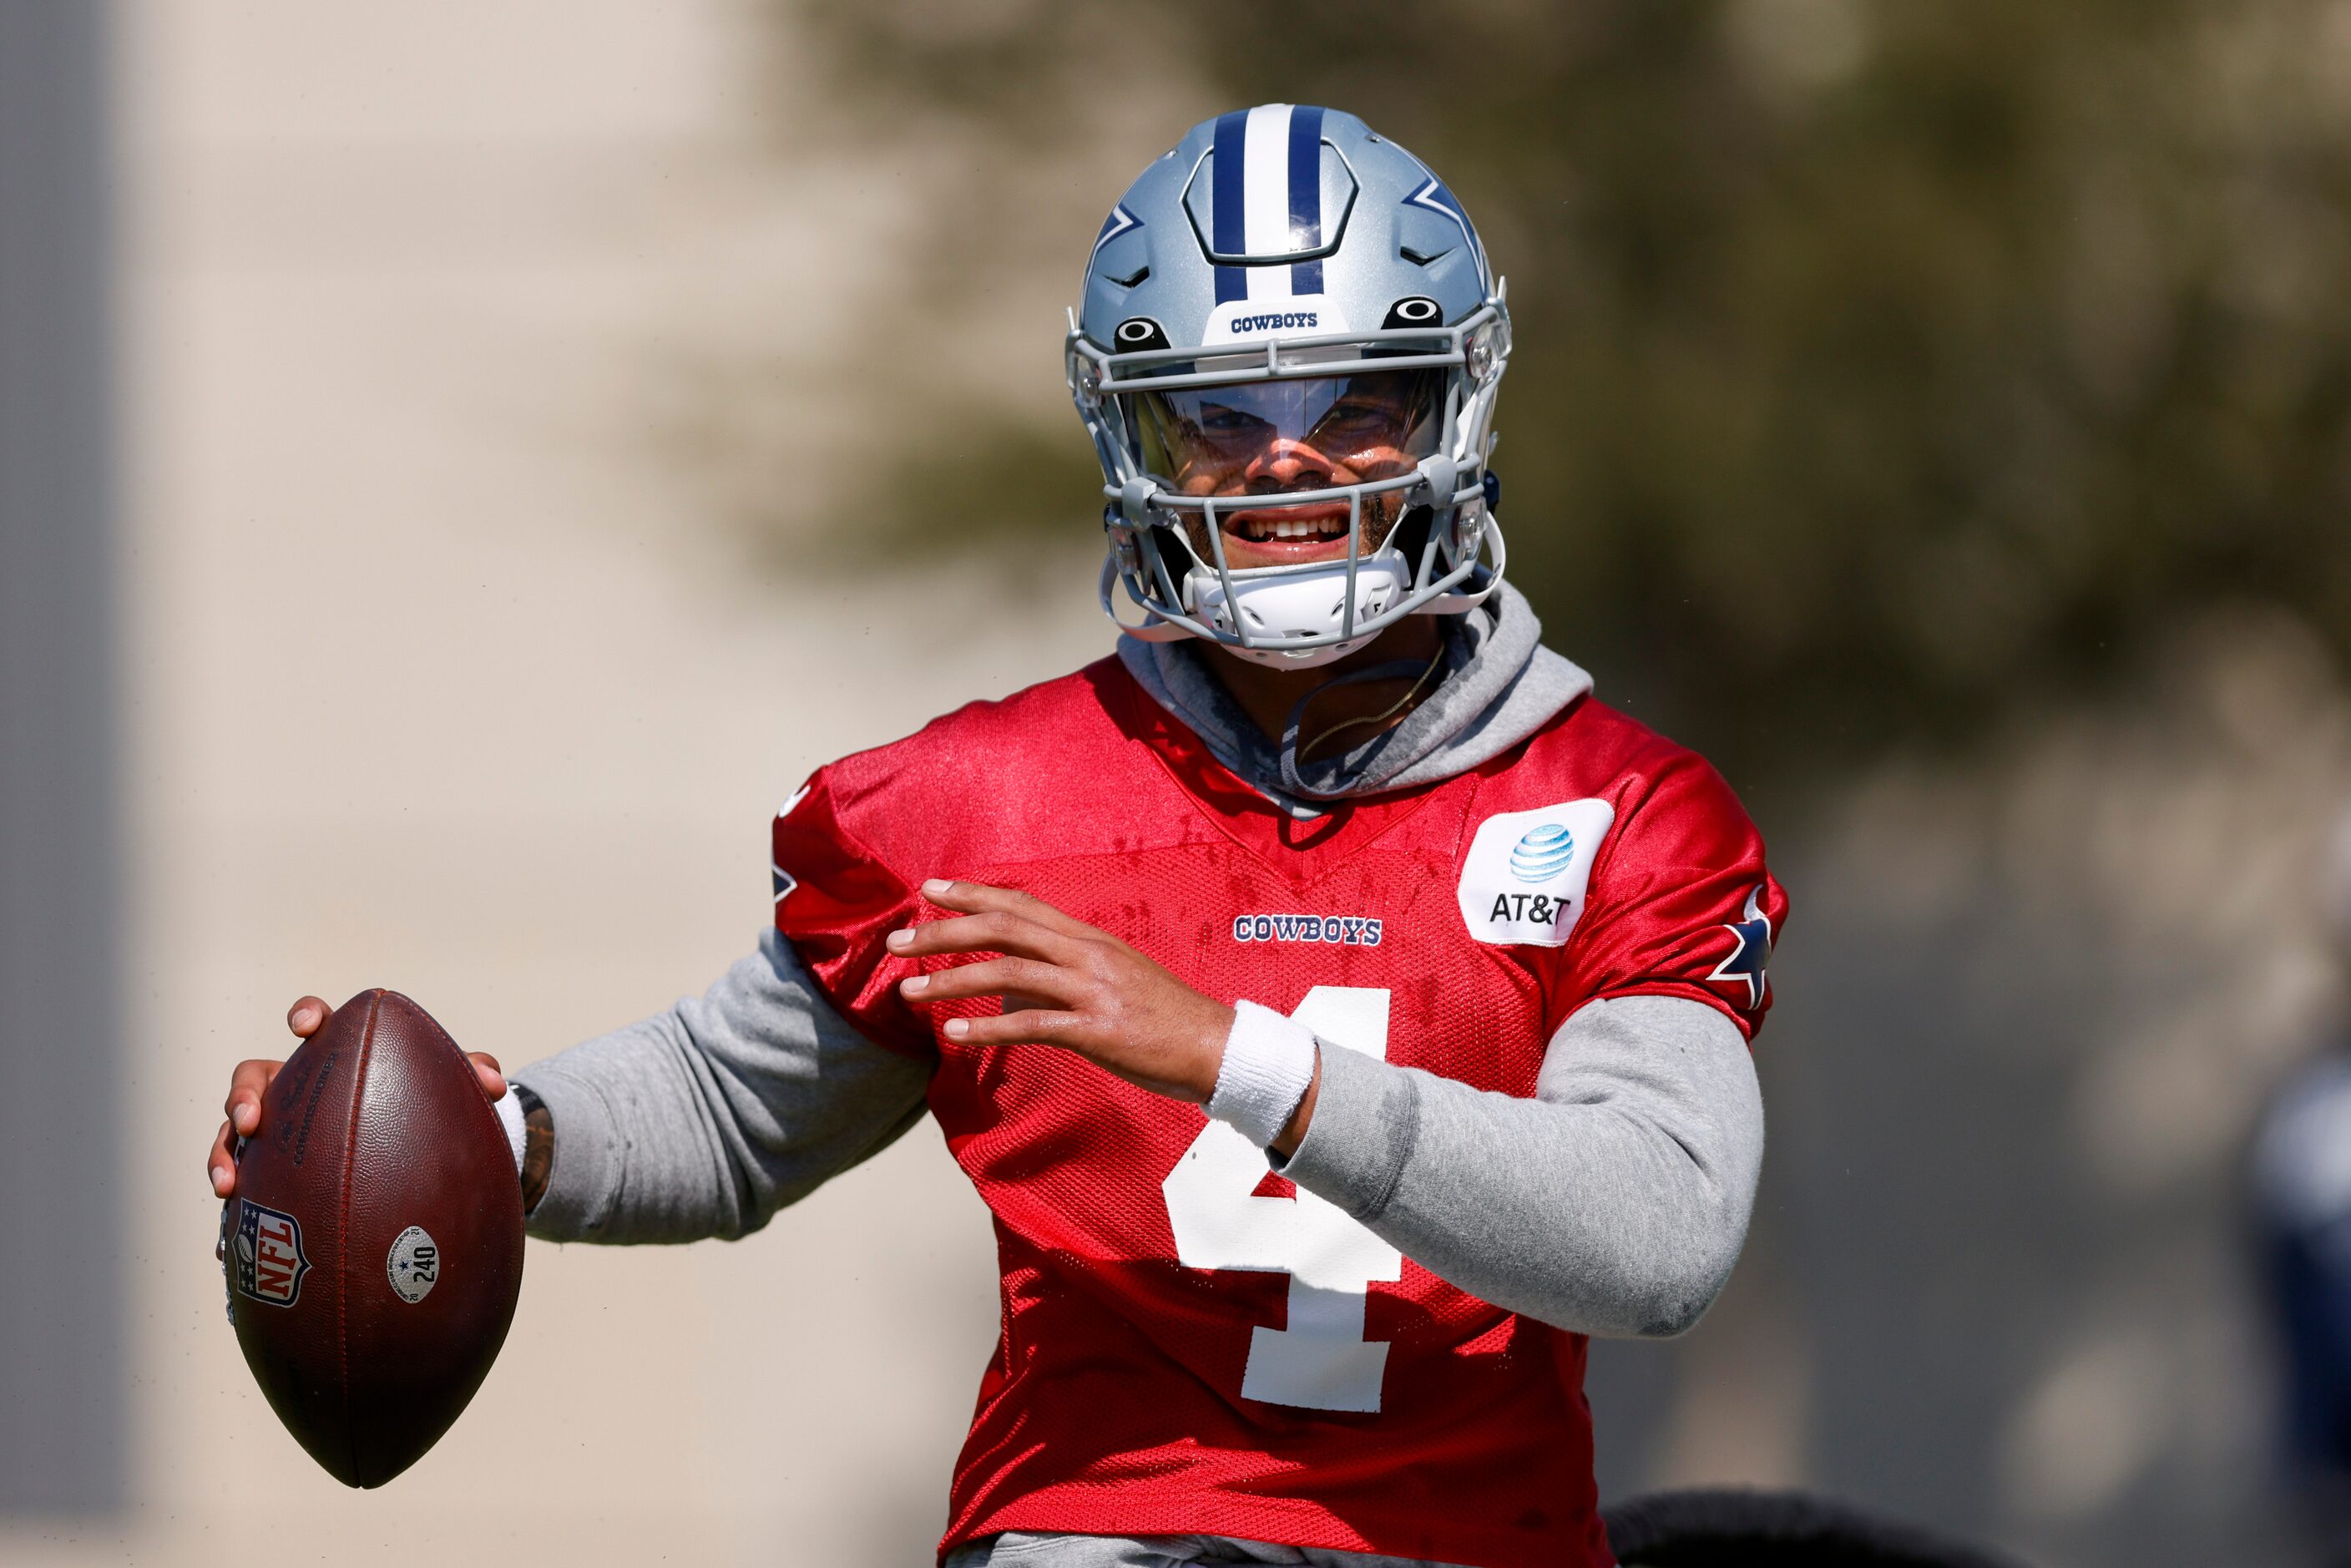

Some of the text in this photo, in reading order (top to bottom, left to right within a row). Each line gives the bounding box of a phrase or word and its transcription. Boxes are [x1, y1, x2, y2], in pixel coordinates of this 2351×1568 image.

[1231, 312, 1318, 333] COWBOYS
[1489, 893, 1571, 925] AT&T
[1233, 913, 1383, 947] COWBOYS
[294, 1052, 339, 1165] COMMISSIONER
[1161, 985, 1402, 1413] 4
[255, 1222, 297, 1297] NFL
[413, 1247, 436, 1282] 240
